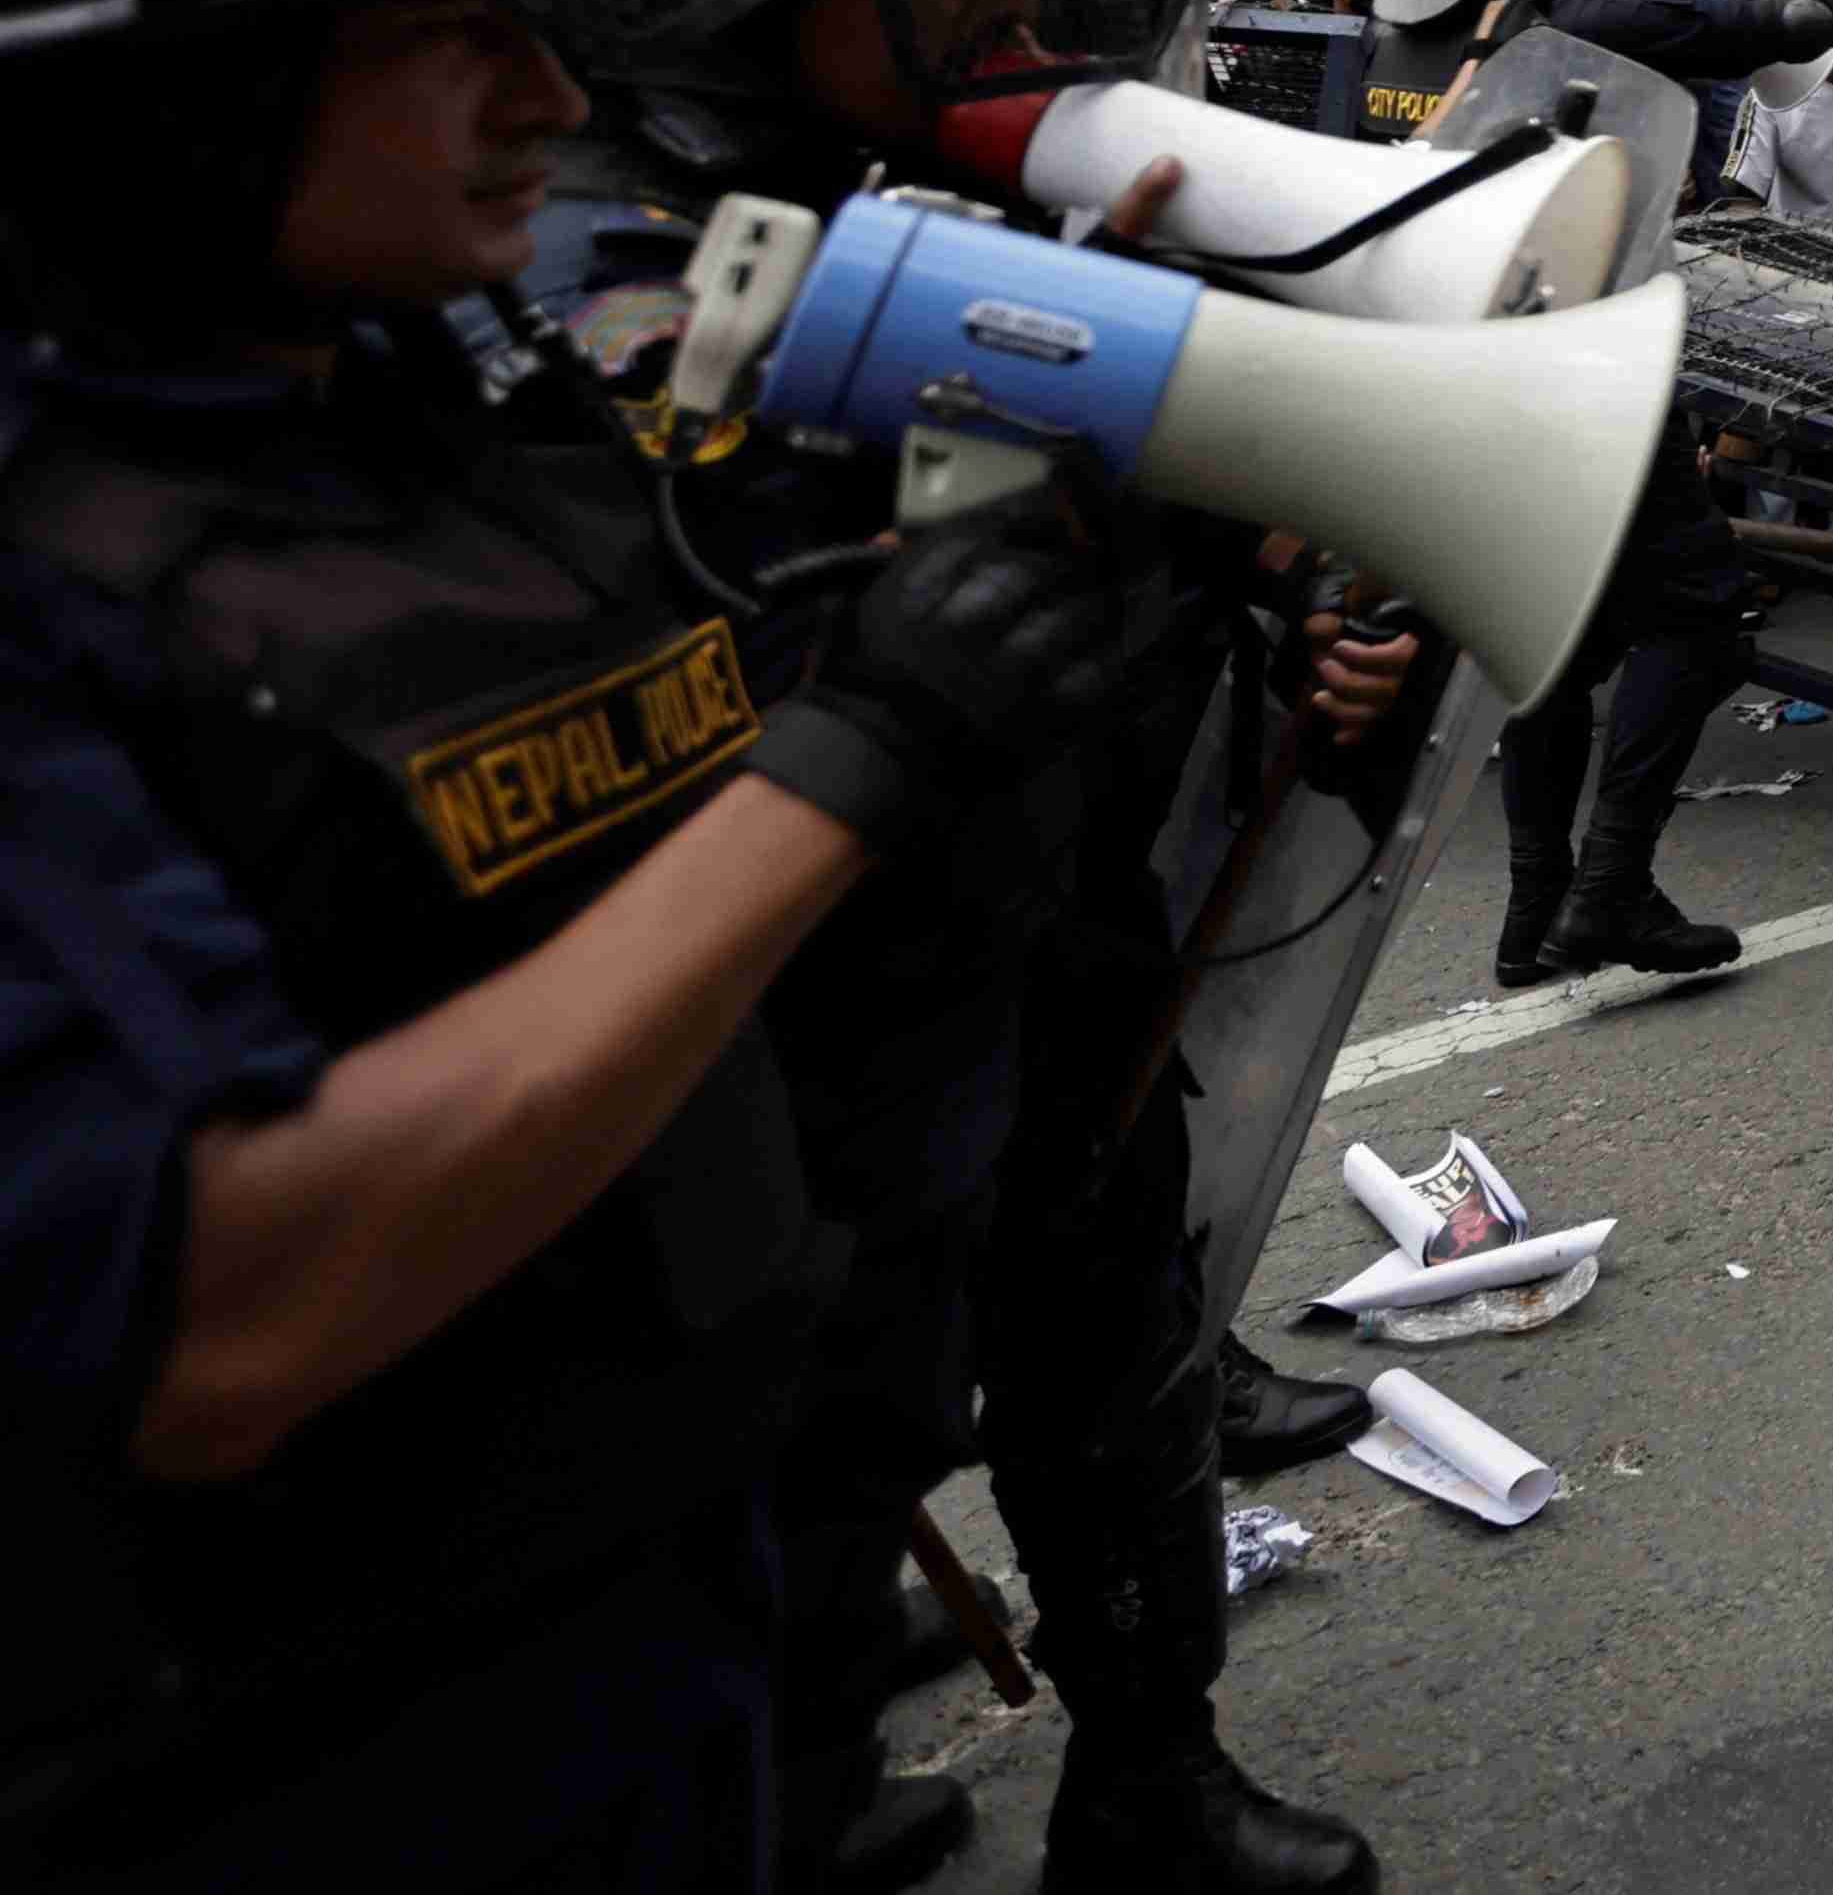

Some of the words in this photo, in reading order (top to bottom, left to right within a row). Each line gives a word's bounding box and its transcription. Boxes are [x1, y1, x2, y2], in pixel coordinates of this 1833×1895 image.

[1367, 87, 1397, 119] CITY
[1396, 90, 1441, 121] POLIC
[430, 712, 646, 864] NEPAL
